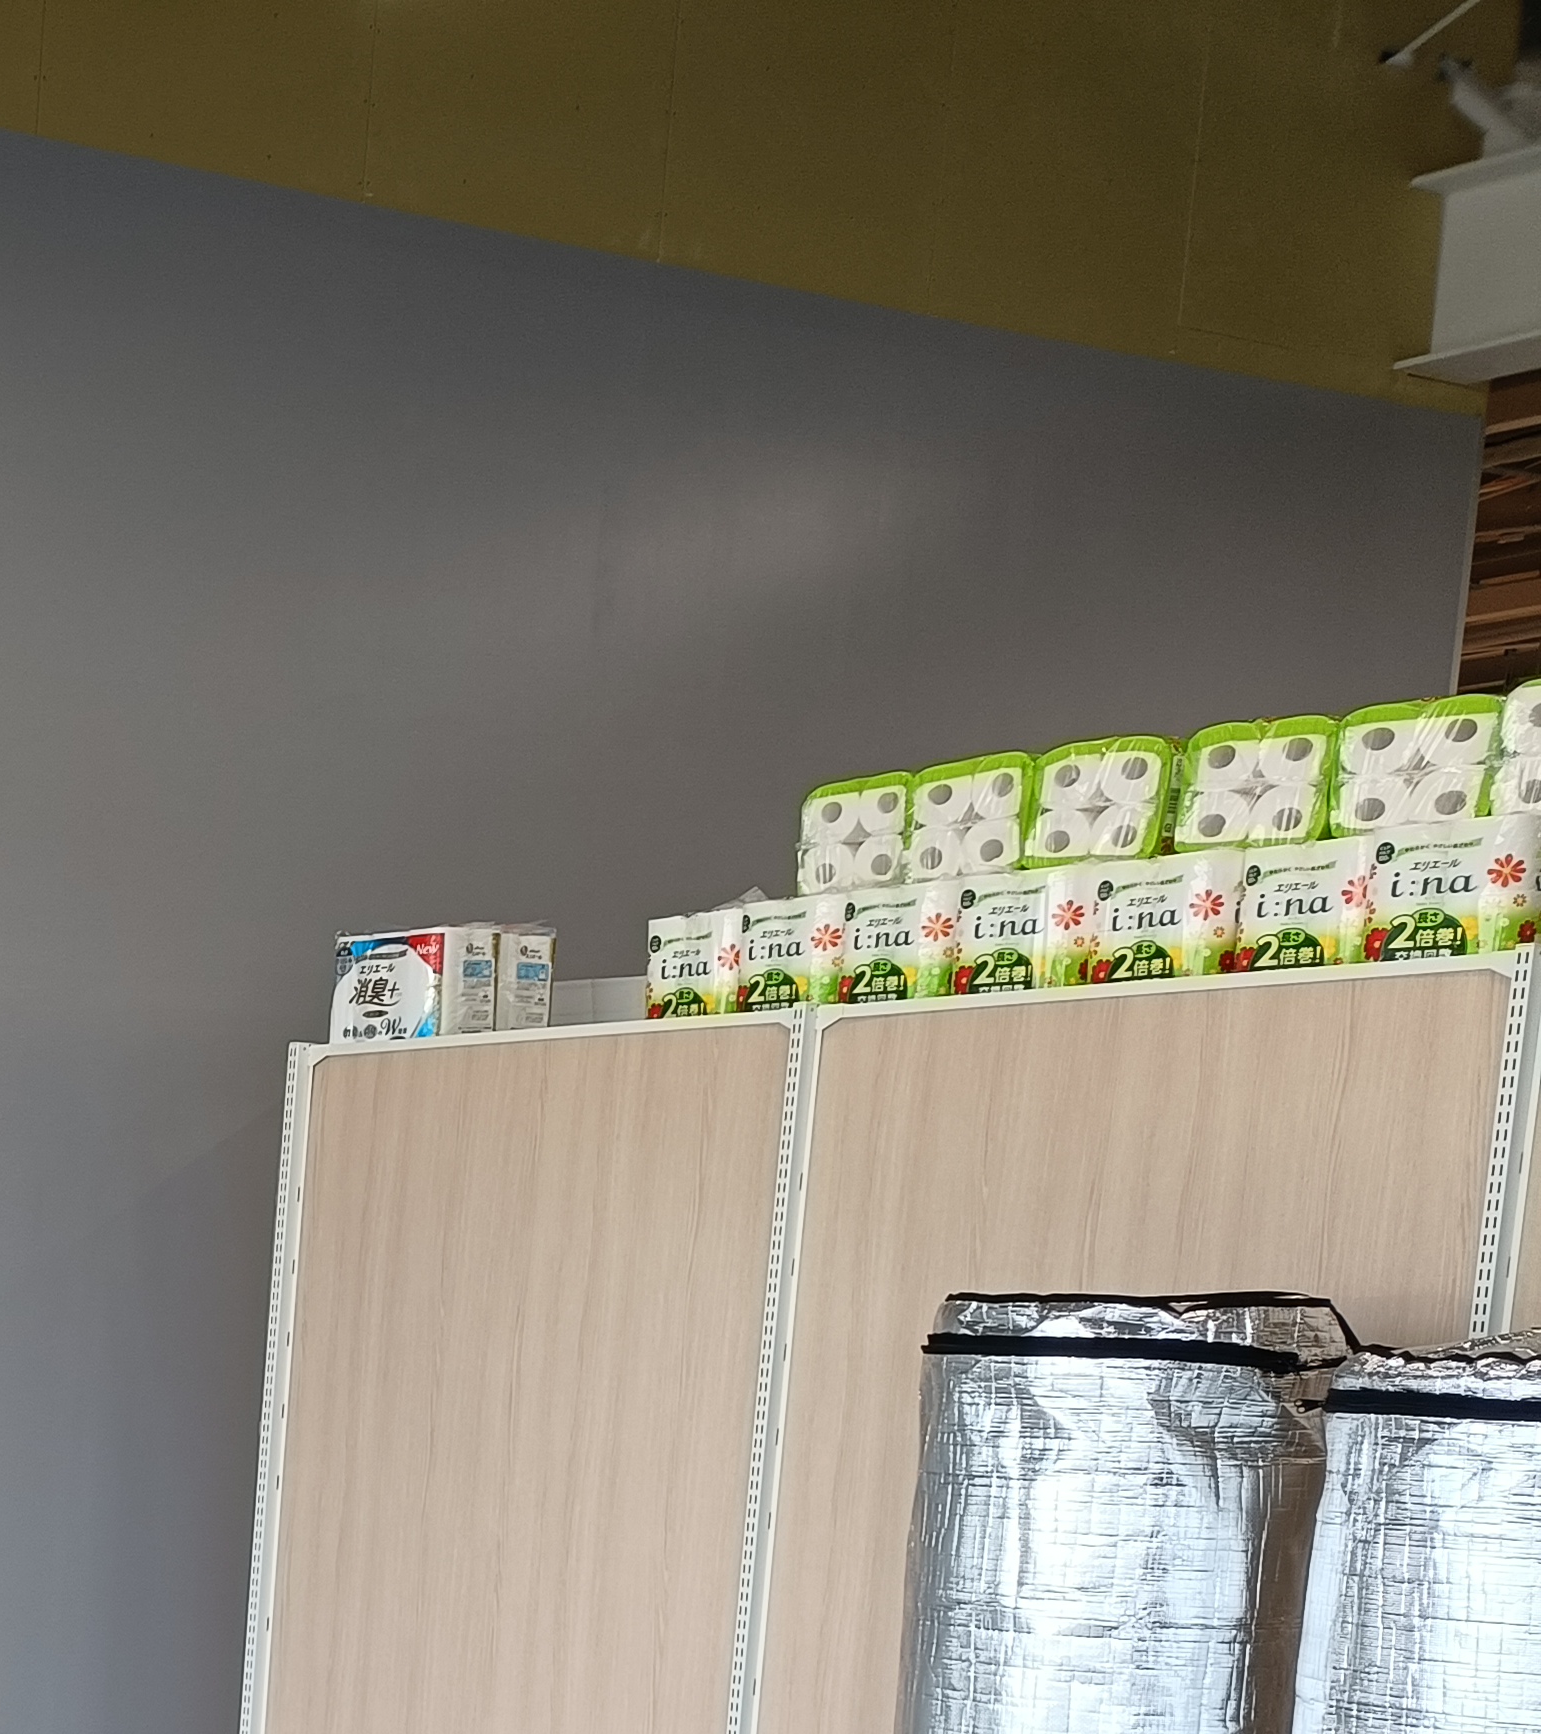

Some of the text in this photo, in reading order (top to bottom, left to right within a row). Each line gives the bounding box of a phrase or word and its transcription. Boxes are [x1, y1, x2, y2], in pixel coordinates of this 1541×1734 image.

[1409, 859, 1462, 871] エリエール
[1275, 881, 1319, 893] エリエール
[1391, 872, 1477, 897] i:na
[1127, 895, 1167, 907] エリエール
[1256, 893, 1333, 919] i:na
[989, 905, 1029, 916] エリエール
[866, 917, 903, 927] エリエール
[1112, 908, 1181, 931] i:na
[760, 929, 795, 938] エリエール
[975, 917, 1045, 939] i:na
[854, 928, 914, 950] i:na
[416, 941, 440, 955] New
[672, 949, 701, 959] エリエール
[748, 940, 805, 961] i:na
[359, 963, 395, 975] エリエール
[661, 959, 711, 980] i:na
